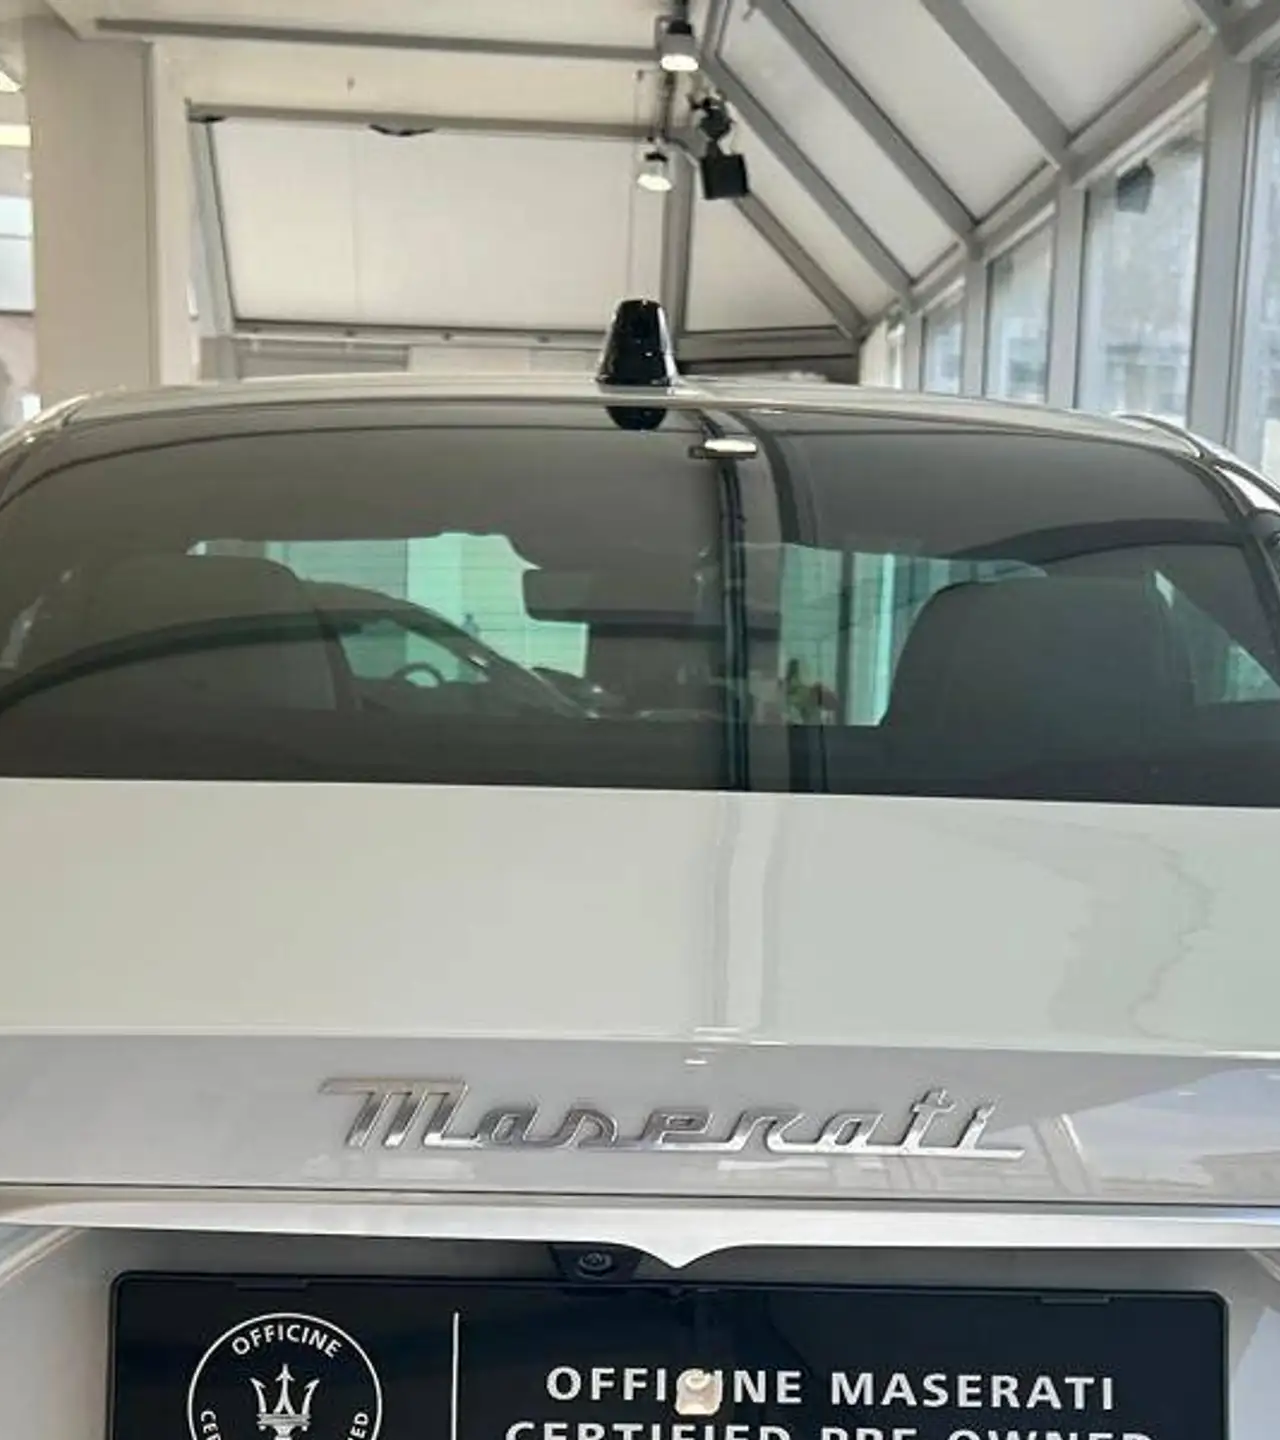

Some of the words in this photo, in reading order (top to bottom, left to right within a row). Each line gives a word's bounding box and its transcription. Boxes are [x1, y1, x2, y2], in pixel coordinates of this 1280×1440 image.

[319, 1078, 1024, 1162] Maserati
[231, 1323, 343, 1359] OFFICINE
[830, 1371, 1115, 1411] MASERATI
